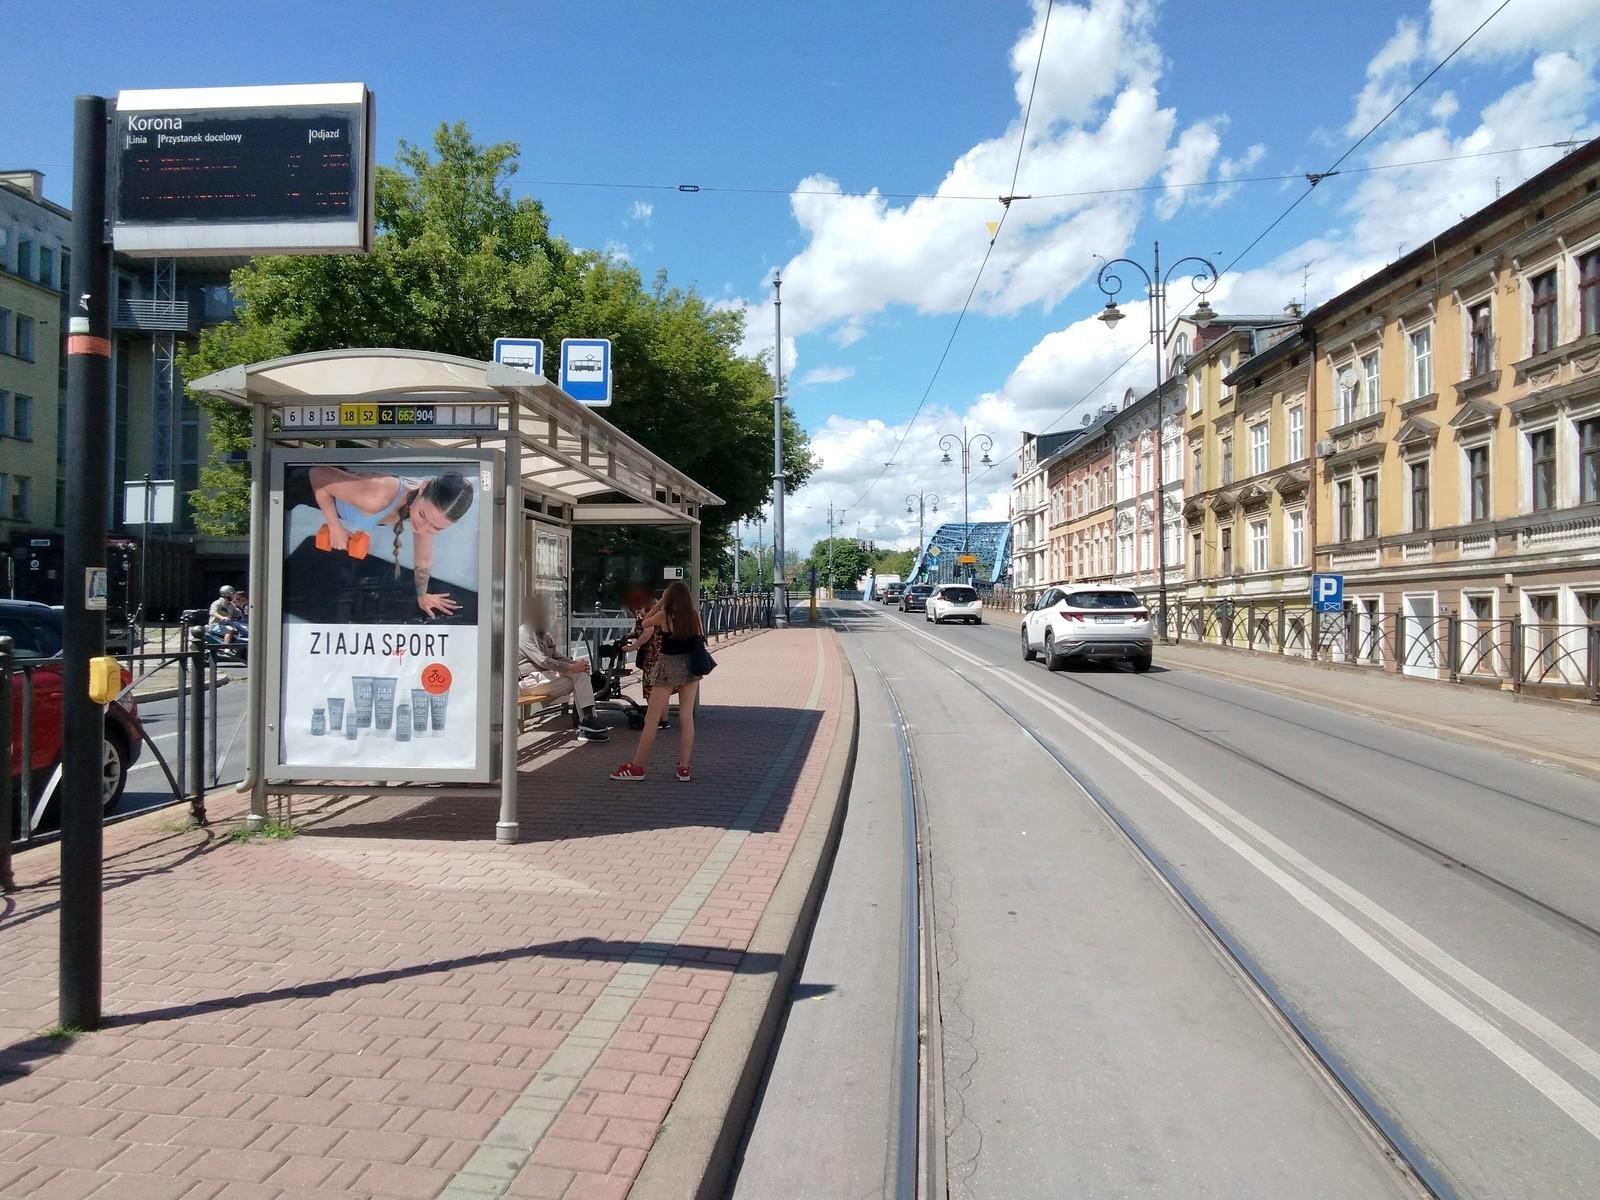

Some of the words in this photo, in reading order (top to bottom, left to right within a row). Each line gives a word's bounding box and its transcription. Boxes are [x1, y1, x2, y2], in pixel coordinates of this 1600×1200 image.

[128, 115, 182, 131] Korona
[128, 135, 148, 145] Linia
[160, 133, 203, 145] Przystanek
[204, 132, 242, 143] docelowy
[311, 129, 340, 140] Odjazd
[290, 411, 296, 421] 6
[309, 411, 315, 422] 8
[325, 411, 336, 422] 13
[344, 411, 355, 422] 18
[363, 411, 374, 422] 52
[381, 411, 393, 422] 62
[398, 411, 414, 422] 662
[416, 410, 434, 421] 904
[1319, 578, 1337, 602] P
[310, 632, 375, 655] ZIAJA
[382, 633, 449, 657] SPORT
